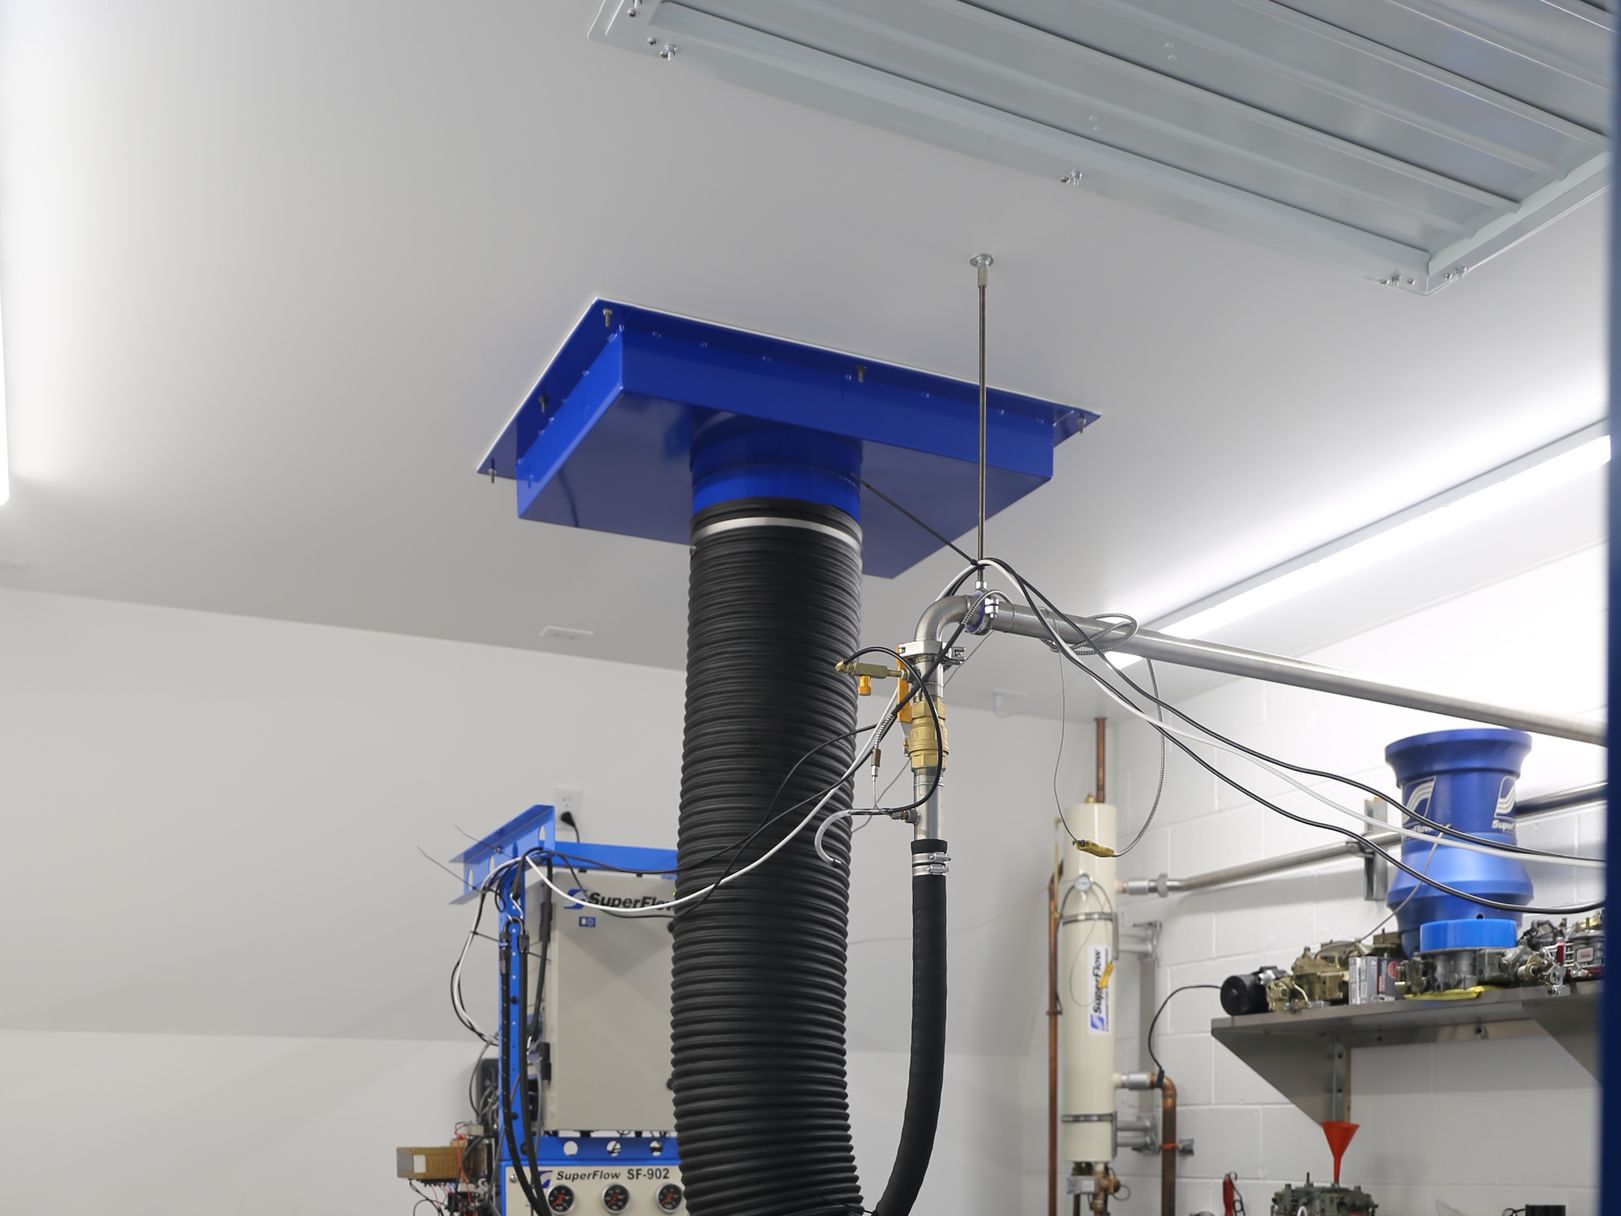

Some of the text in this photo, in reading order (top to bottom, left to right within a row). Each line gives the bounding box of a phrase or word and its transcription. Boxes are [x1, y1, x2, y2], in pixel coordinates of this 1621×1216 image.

[588, 892, 673, 912] SuperFlo
[556, 1168, 670, 1182] SuperFlow SF-902
